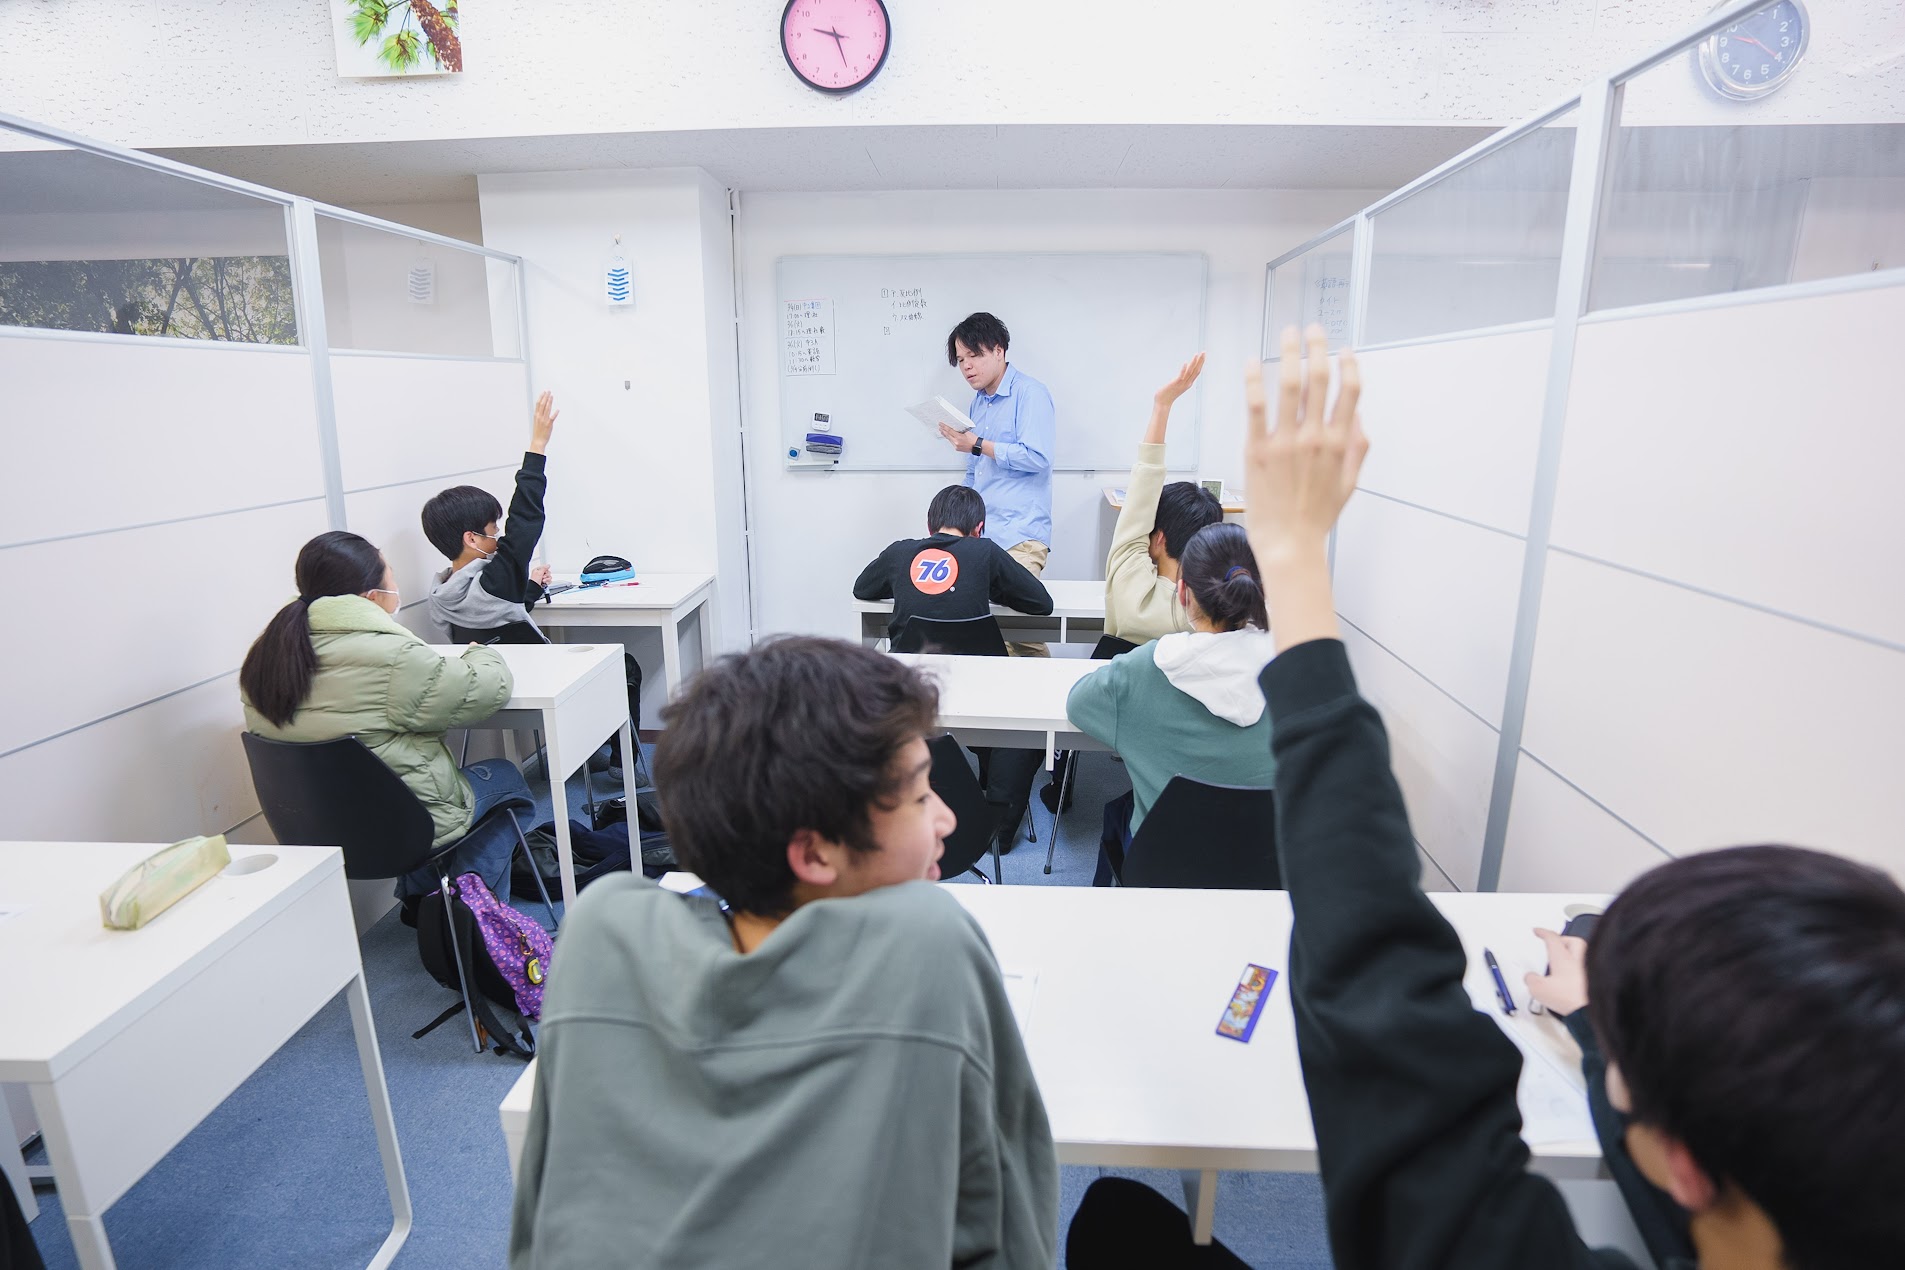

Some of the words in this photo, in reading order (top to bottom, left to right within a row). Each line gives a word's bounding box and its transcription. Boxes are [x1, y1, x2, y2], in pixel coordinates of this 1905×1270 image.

[1772, 9, 1778, 19] 1
[1779, 21, 1788, 32] 2
[1719, 37, 1728, 48] 9
[1781, 37, 1789, 47] 3
[1721, 53, 1730, 63] 8
[1774, 52, 1783, 62] 4
[1732, 64, 1740, 75] 7
[1744, 69, 1752, 80] 6
[1761, 64, 1769, 75] 5
[915, 556, 952, 583] 76
